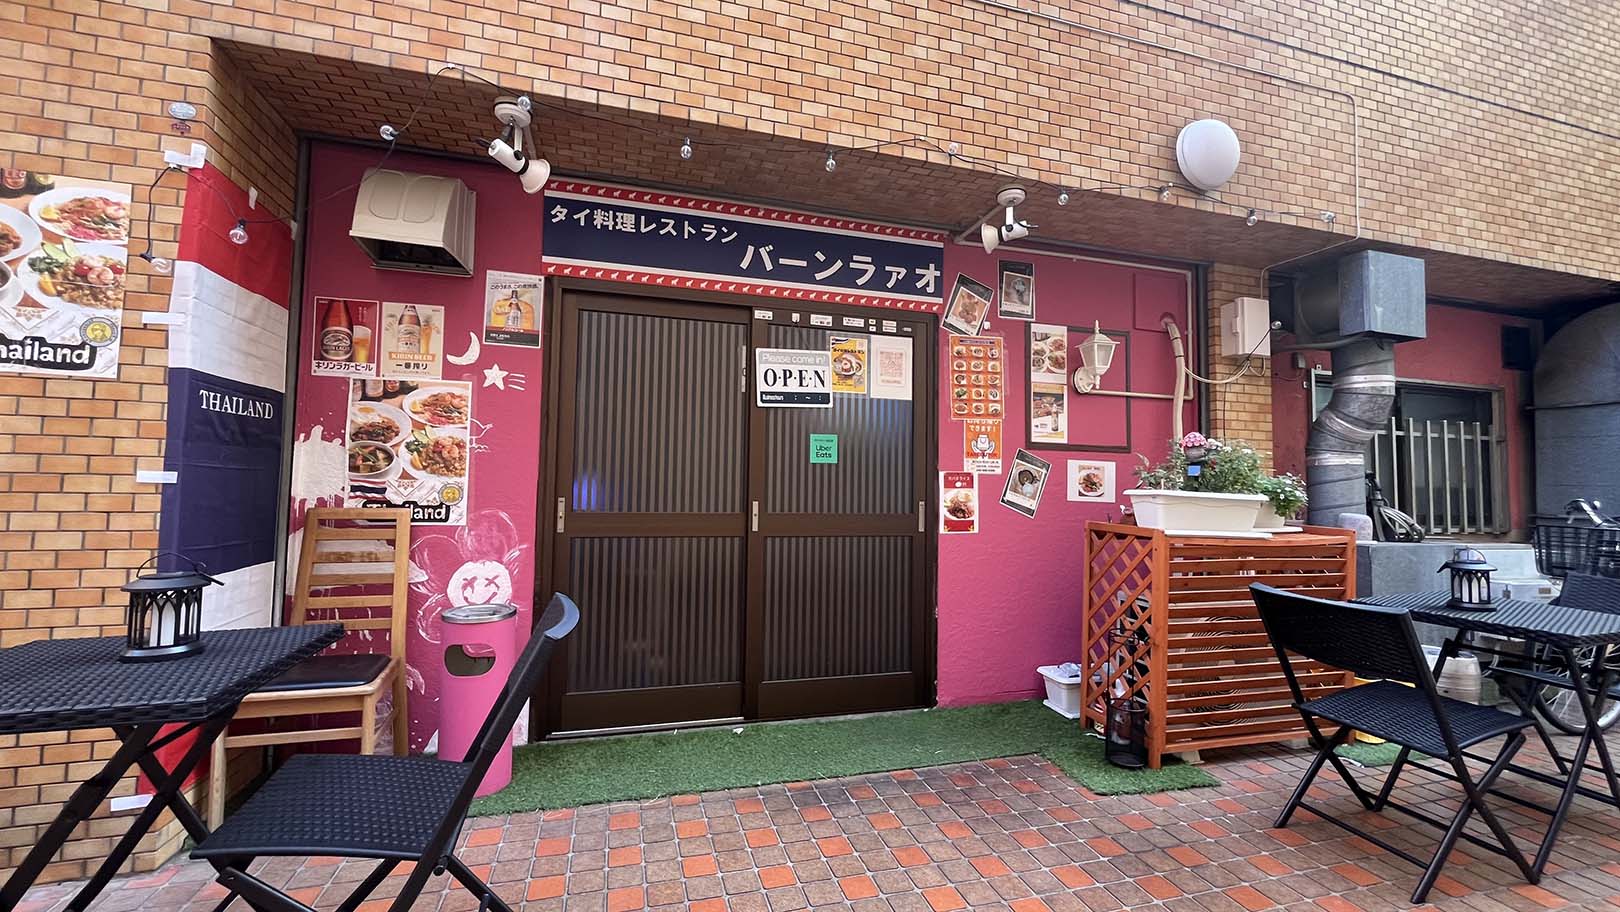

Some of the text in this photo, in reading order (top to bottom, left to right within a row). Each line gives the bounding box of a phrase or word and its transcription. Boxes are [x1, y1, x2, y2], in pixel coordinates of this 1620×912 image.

[550, 205, 738, 244] タイ料理レストラン
[740, 244, 940, 294] バーンラァオ
[762, 352, 791, 364] Please
[792, 356, 815, 364] come
[315, 361, 374, 372] キリンラガービール
[199, 389, 274, 419] THAILAND
[815, 444, 833, 452] Uber
[815, 451, 833, 459] Eats
